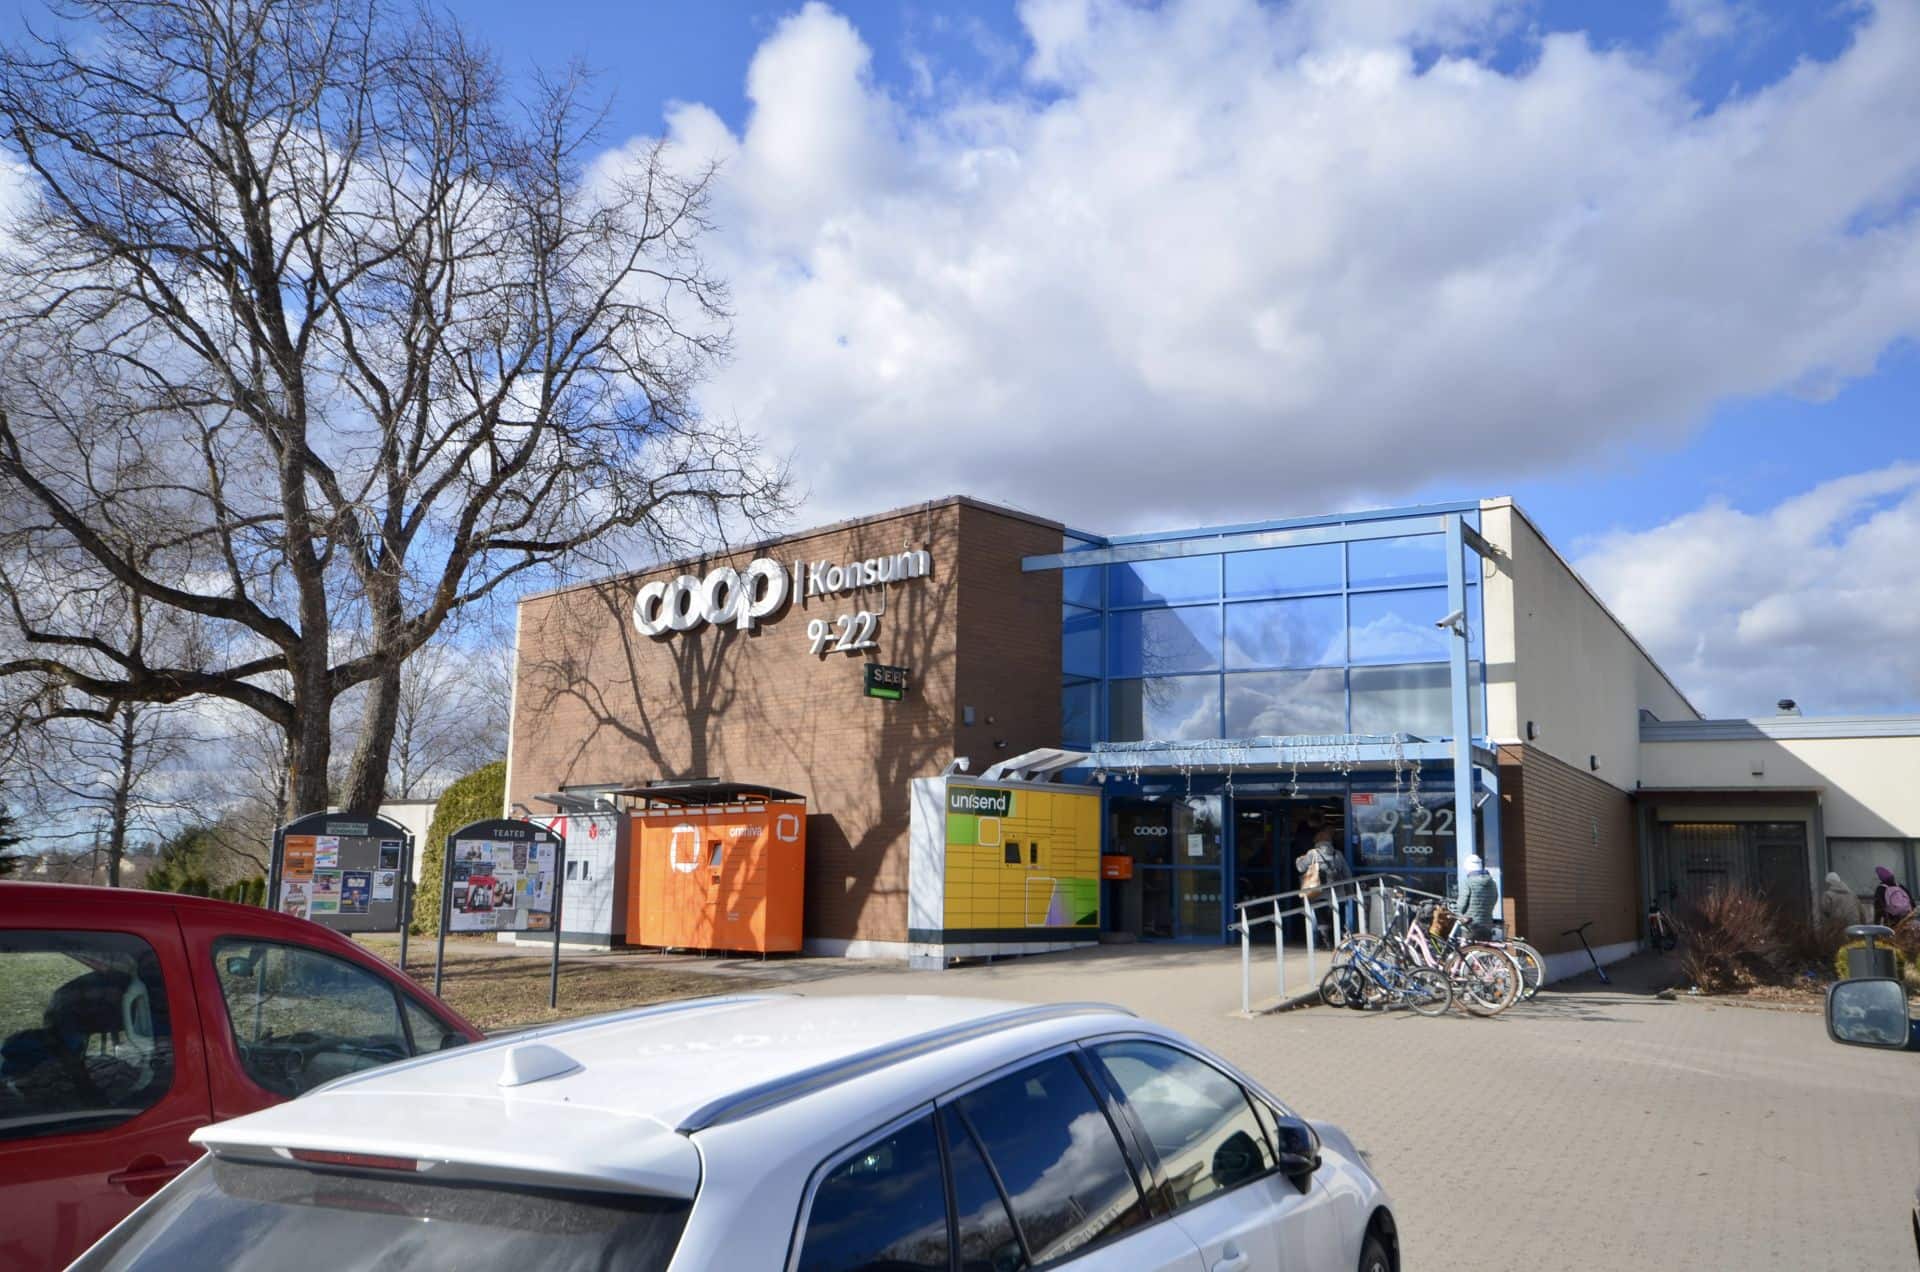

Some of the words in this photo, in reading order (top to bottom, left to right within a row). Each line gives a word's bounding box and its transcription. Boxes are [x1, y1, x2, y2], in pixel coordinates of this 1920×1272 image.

[633, 557, 789, 636] coop
[808, 549, 931, 595] Konsum
[807, 610, 878, 655] 9-22
[951, 792, 1006, 811] unisend
[1133, 826, 1168, 837] coop
[1381, 808, 1455, 836] 9-22
[1402, 845, 1434, 855] coop
